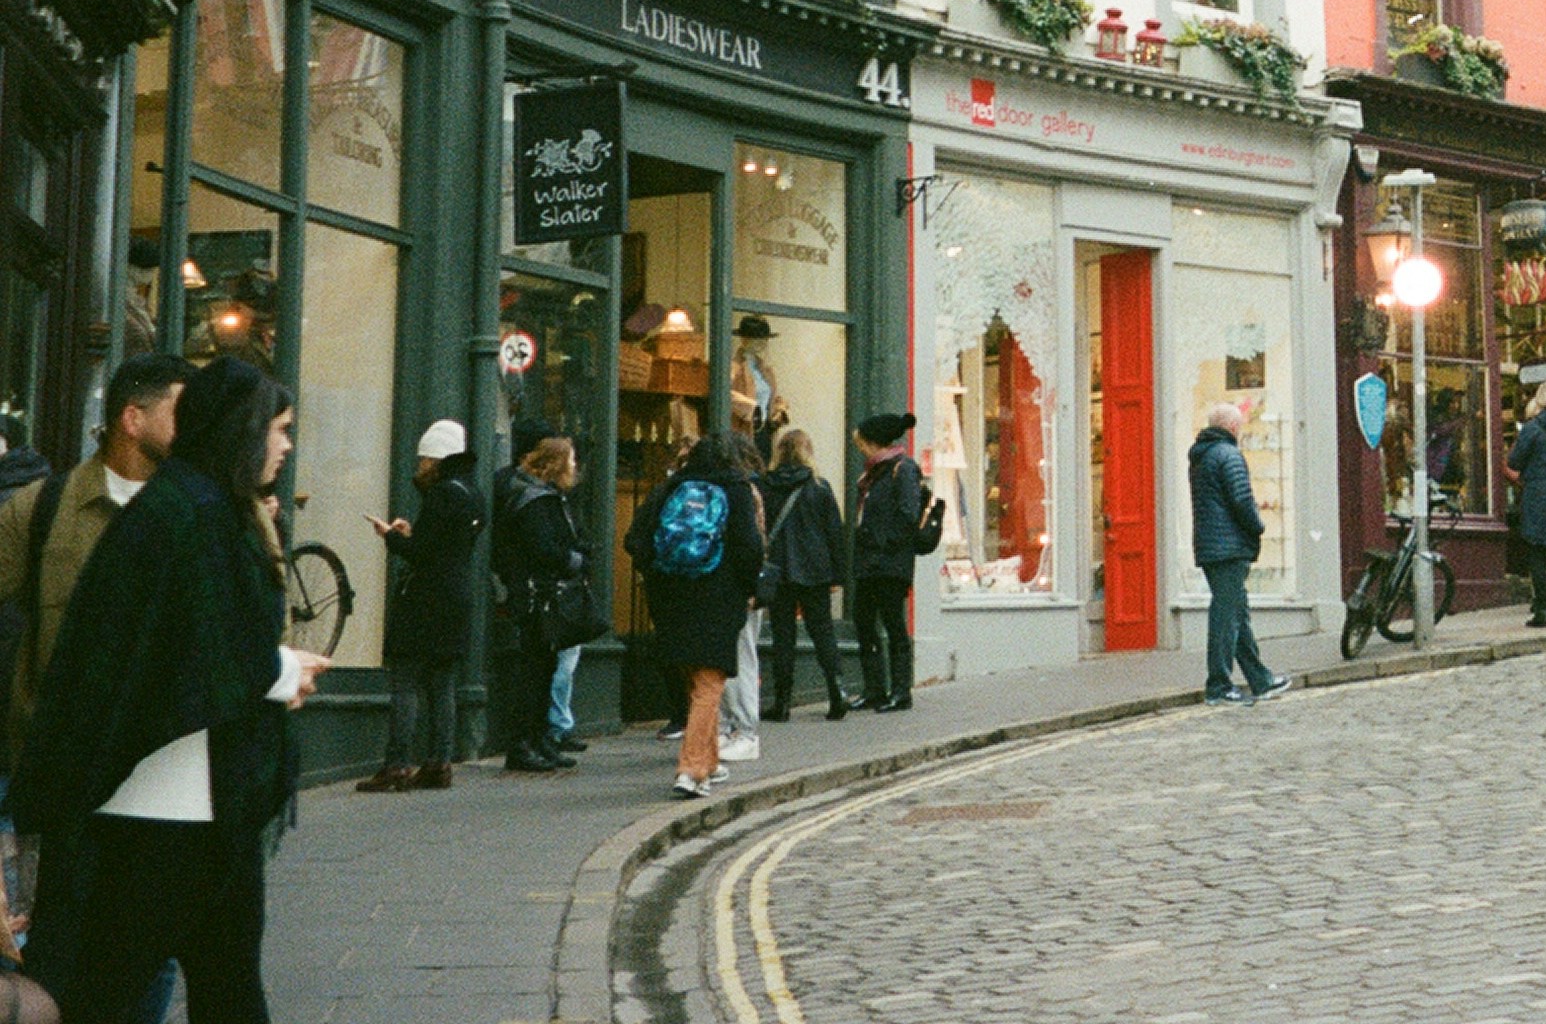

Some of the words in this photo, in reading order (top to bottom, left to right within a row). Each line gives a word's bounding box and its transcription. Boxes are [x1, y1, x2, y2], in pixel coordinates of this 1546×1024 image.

[972, 96, 995, 121] red
[997, 100, 1034, 127] door
[1041, 109, 1096, 143] gallery
